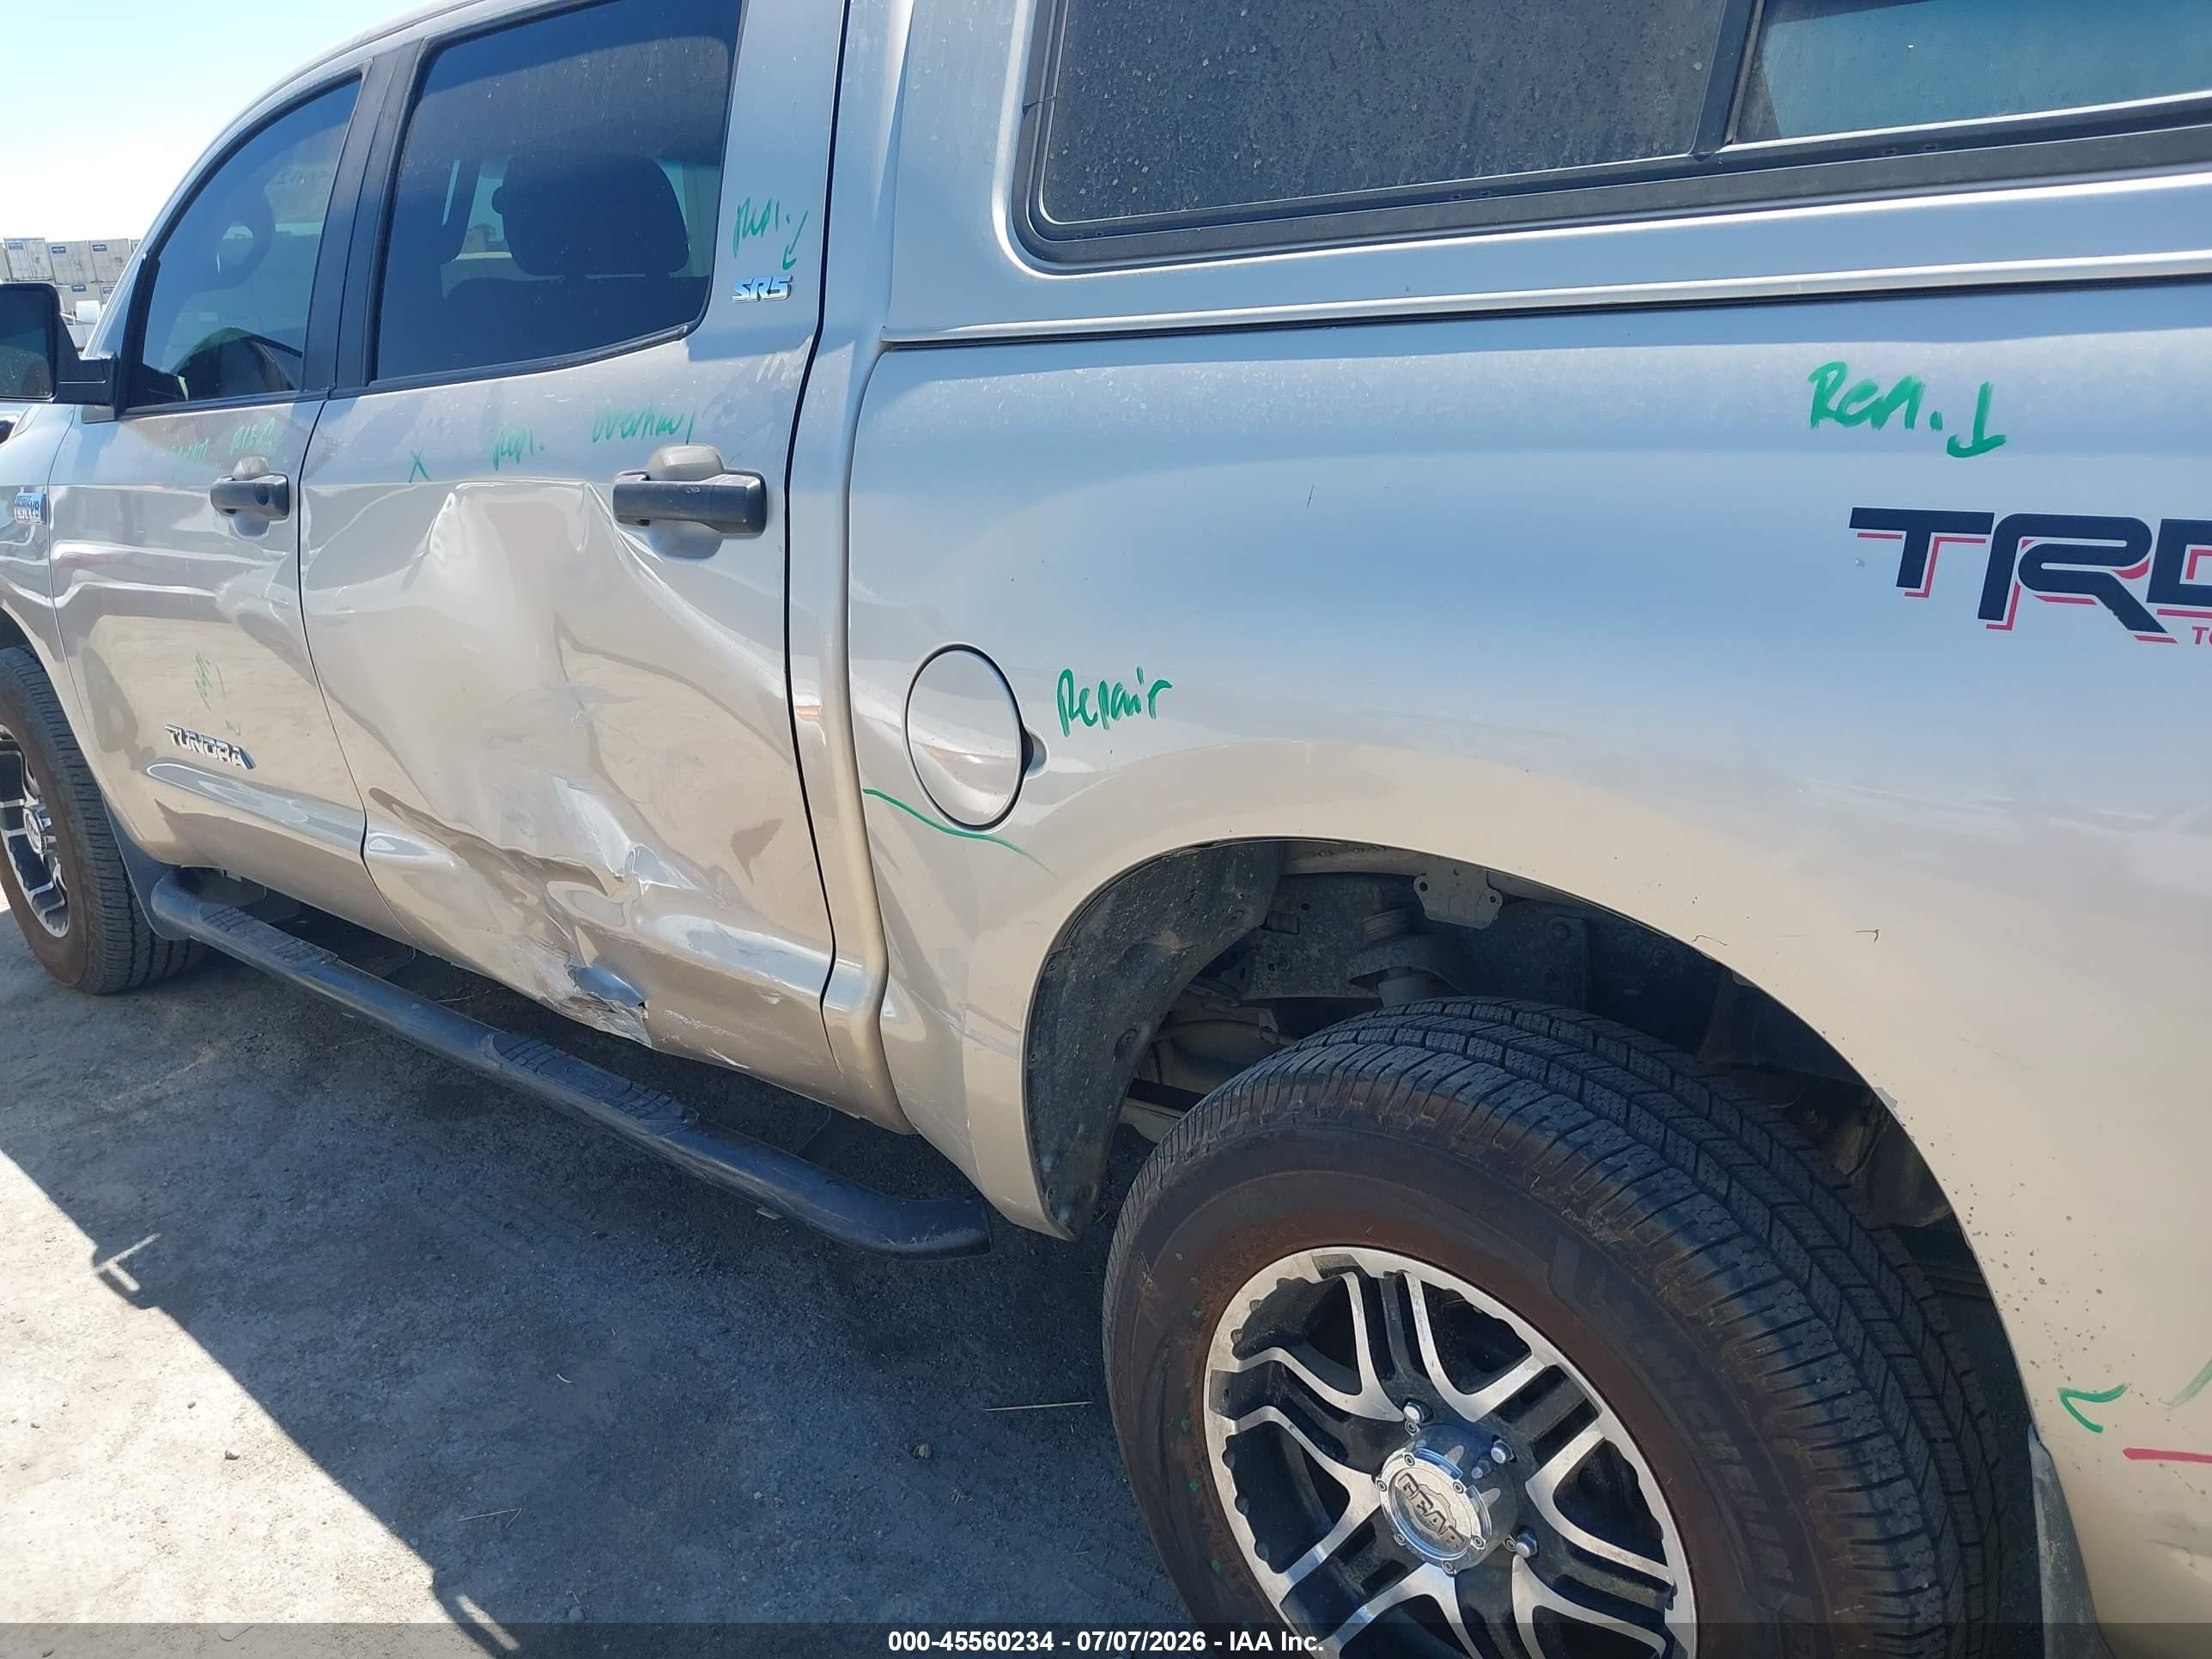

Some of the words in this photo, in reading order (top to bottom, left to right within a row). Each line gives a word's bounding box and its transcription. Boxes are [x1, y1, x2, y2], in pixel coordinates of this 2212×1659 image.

[732, 275, 793, 303] SR5
[1056, 665, 1173, 738] Repair
[164, 723, 257, 770] TUNDRA
